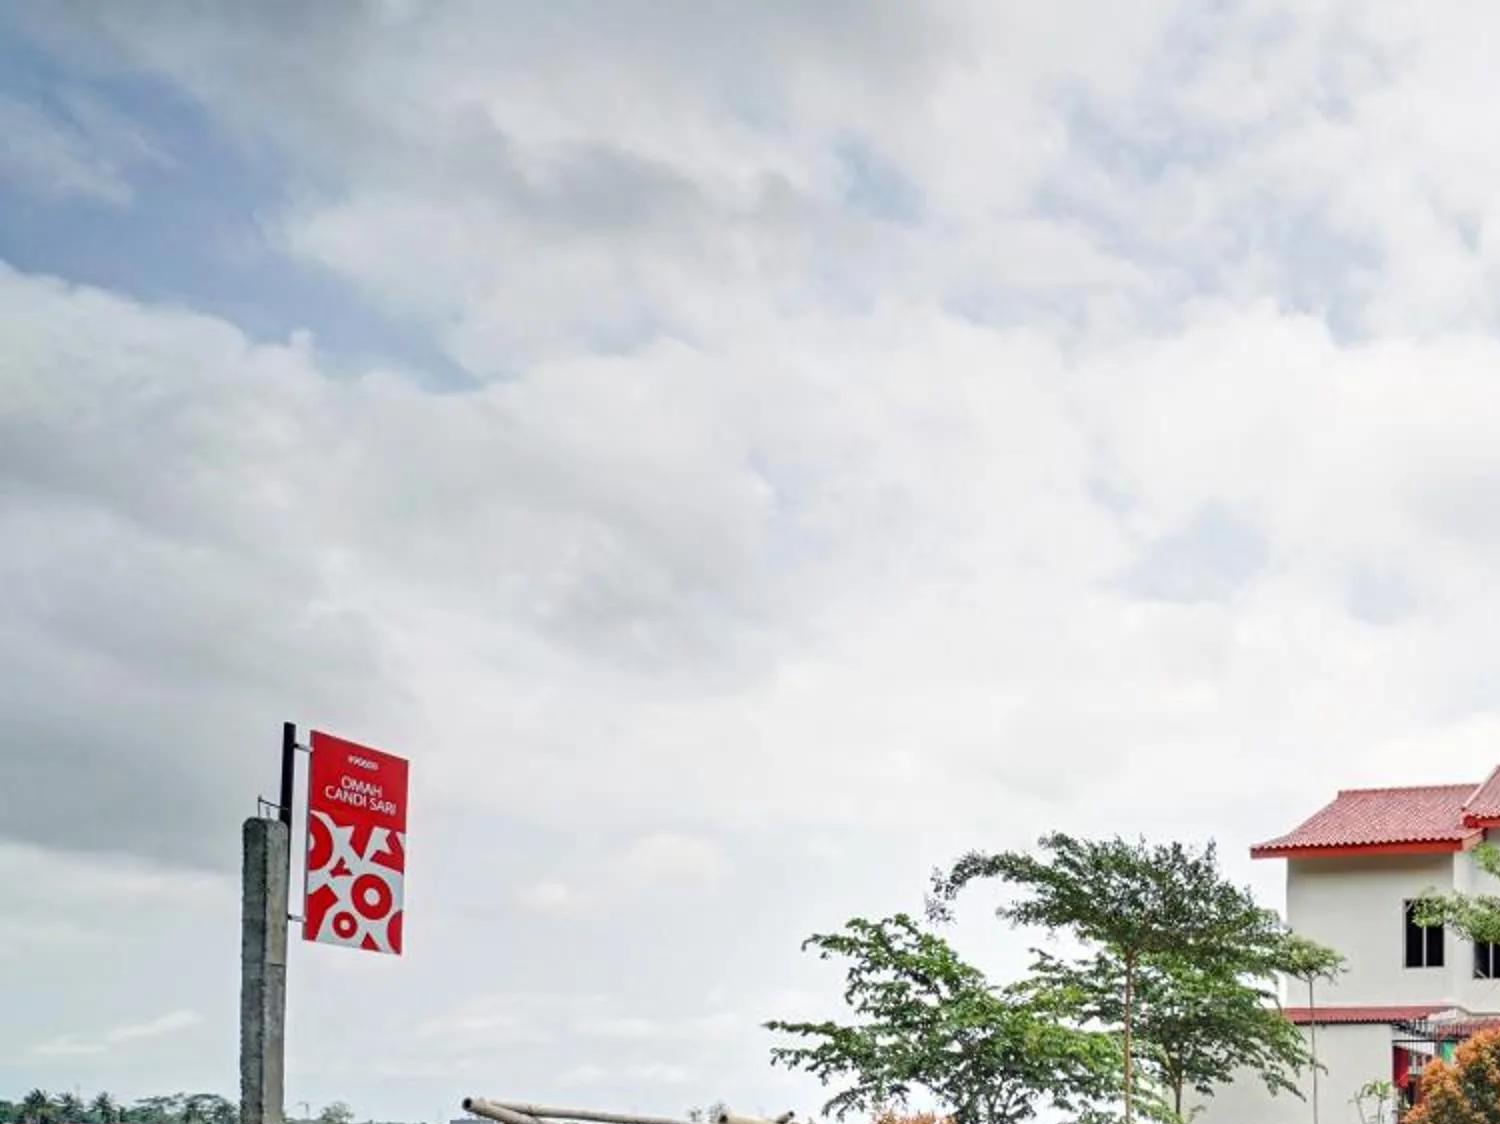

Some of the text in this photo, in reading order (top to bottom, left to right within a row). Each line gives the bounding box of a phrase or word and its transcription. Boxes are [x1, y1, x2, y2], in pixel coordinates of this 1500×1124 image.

[341, 775, 382, 798] OMAH
[325, 785, 397, 816] CANDI SARI
